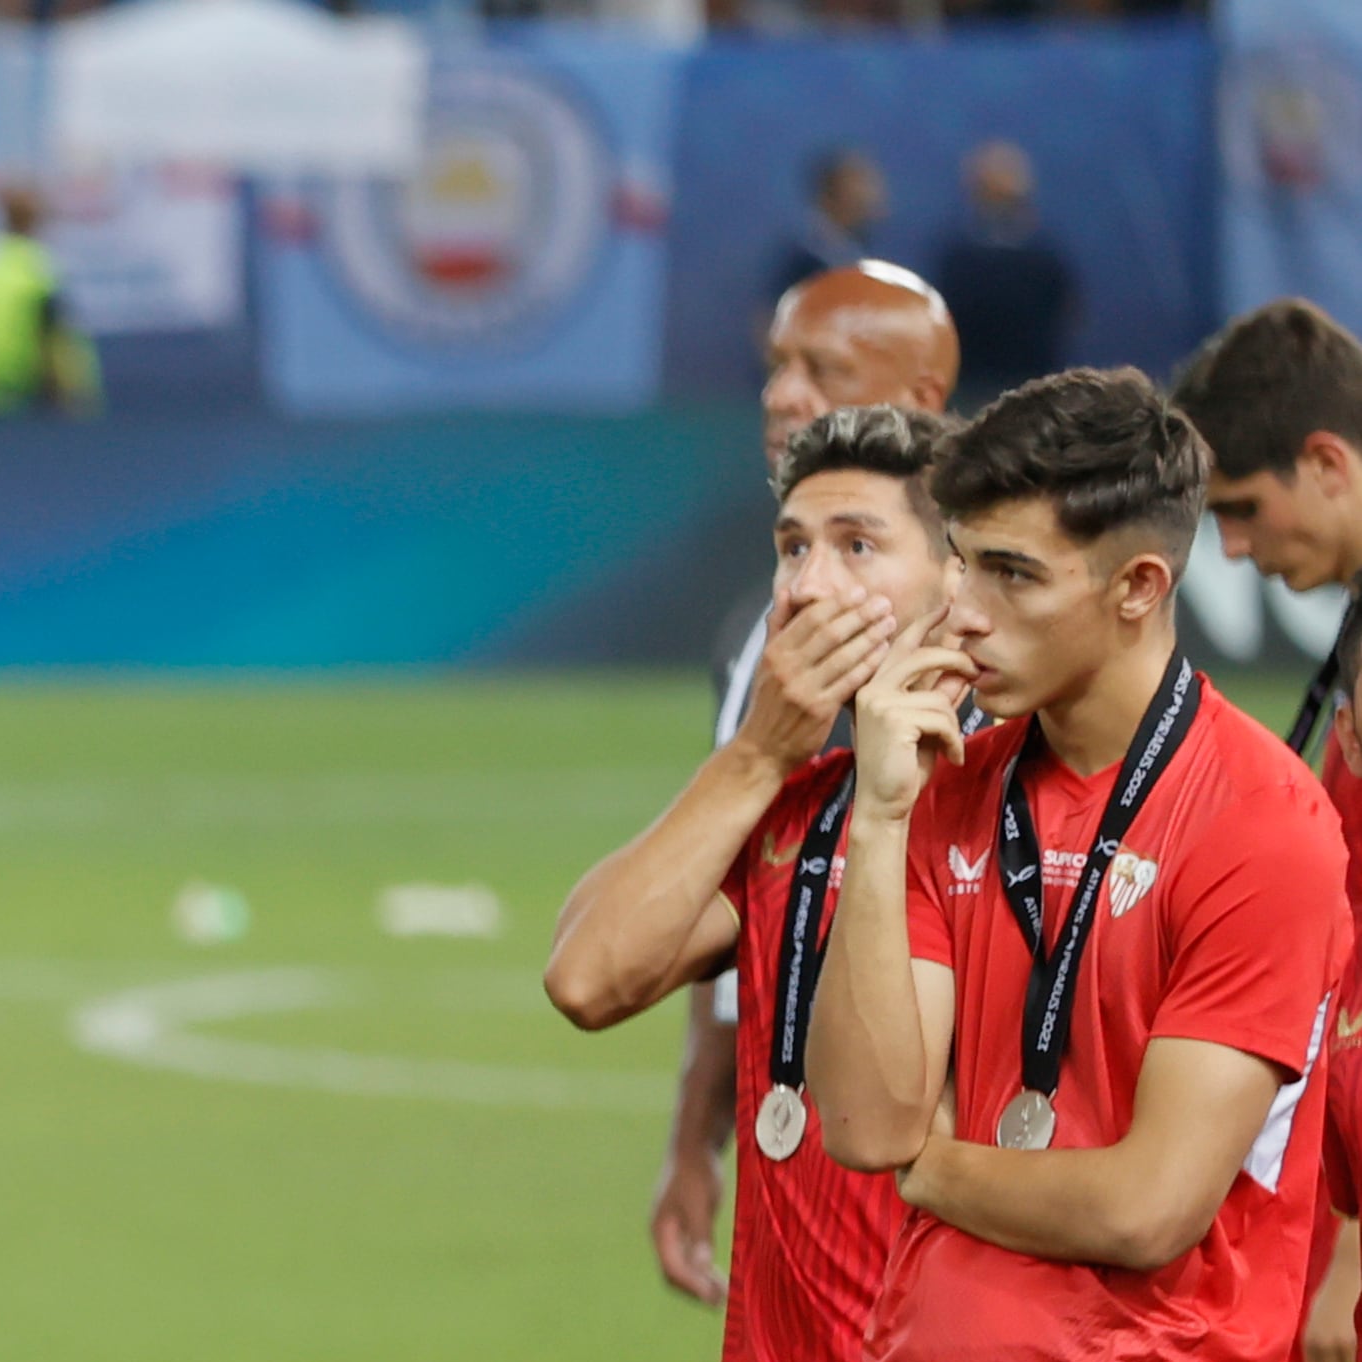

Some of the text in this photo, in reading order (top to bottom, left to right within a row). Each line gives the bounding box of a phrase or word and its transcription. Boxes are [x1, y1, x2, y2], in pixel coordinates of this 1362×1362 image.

[1137, 711, 1175, 769] PIRAEUS
[1118, 766, 1147, 808] 2023
[1036, 867, 1101, 1052] ATHENS PIRAEUS 2023
